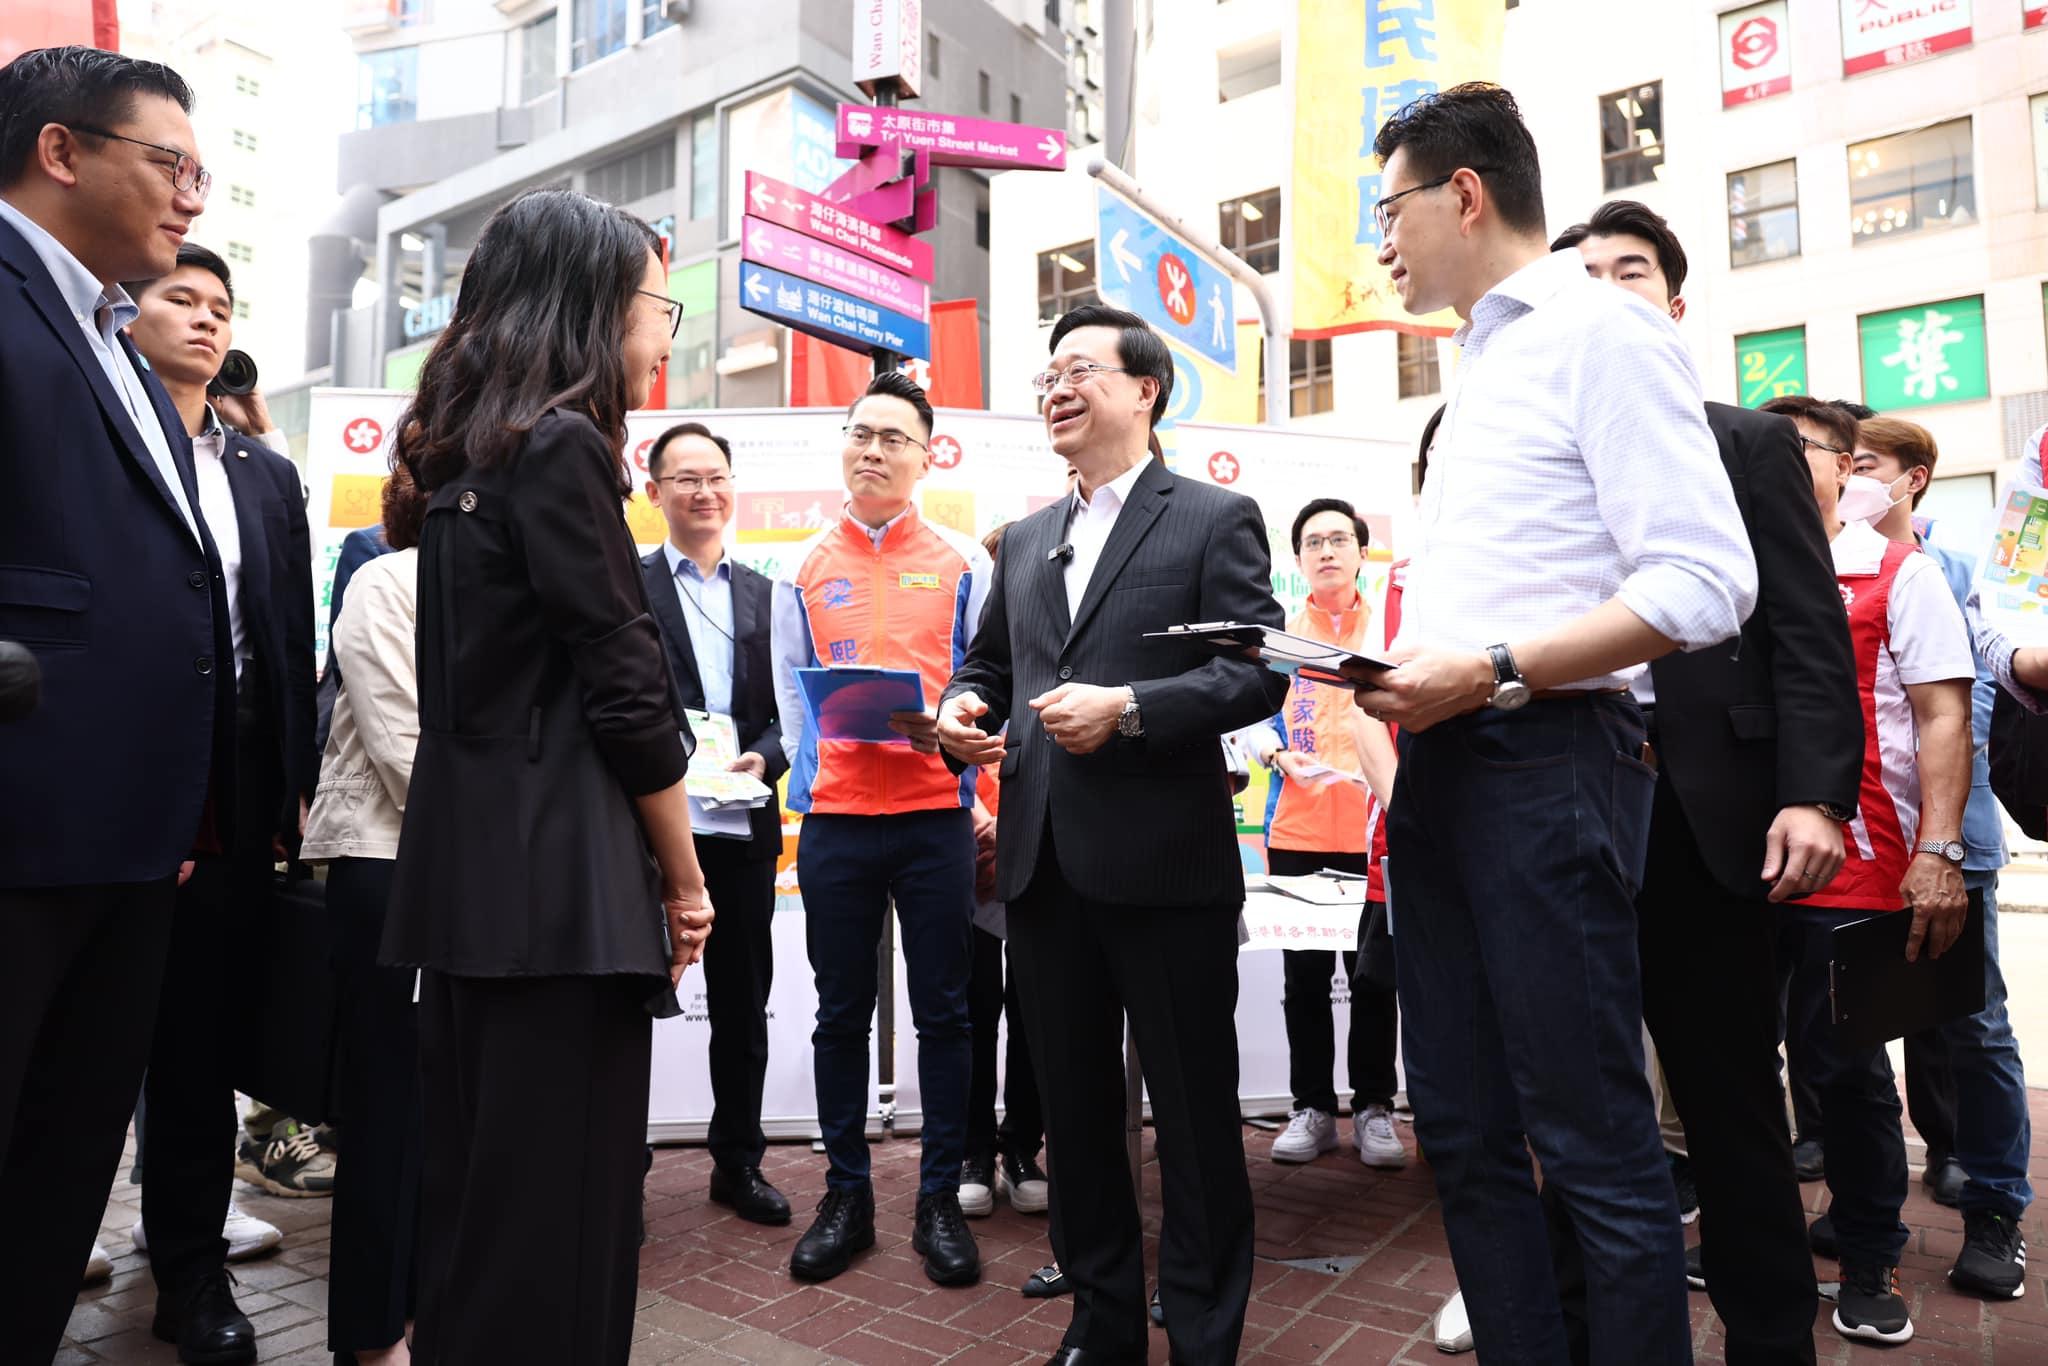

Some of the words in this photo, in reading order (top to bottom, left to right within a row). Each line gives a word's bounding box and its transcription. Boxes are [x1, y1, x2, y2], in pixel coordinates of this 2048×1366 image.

[1859, 1, 1957, 33] PUBLIC
[868, 31, 883, 69] Wan
[1743, 85, 1770, 100] 4/F
[881, 114, 956, 136] 太原街市集
[903, 131, 935, 147] Yuen
[937, 135, 976, 152] Street
[977, 140, 1018, 157] Market
[809, 218, 834, 237] Wan
[836, 227, 859, 248] Chai
[861, 237, 913, 270] Promenade
[807, 307, 831, 325] Wan
[833, 313, 857, 332] Chai
[858, 321, 883, 343] Ferry
[885, 331, 904, 348] Pier
[1881, 309, 1965, 400] 葉
